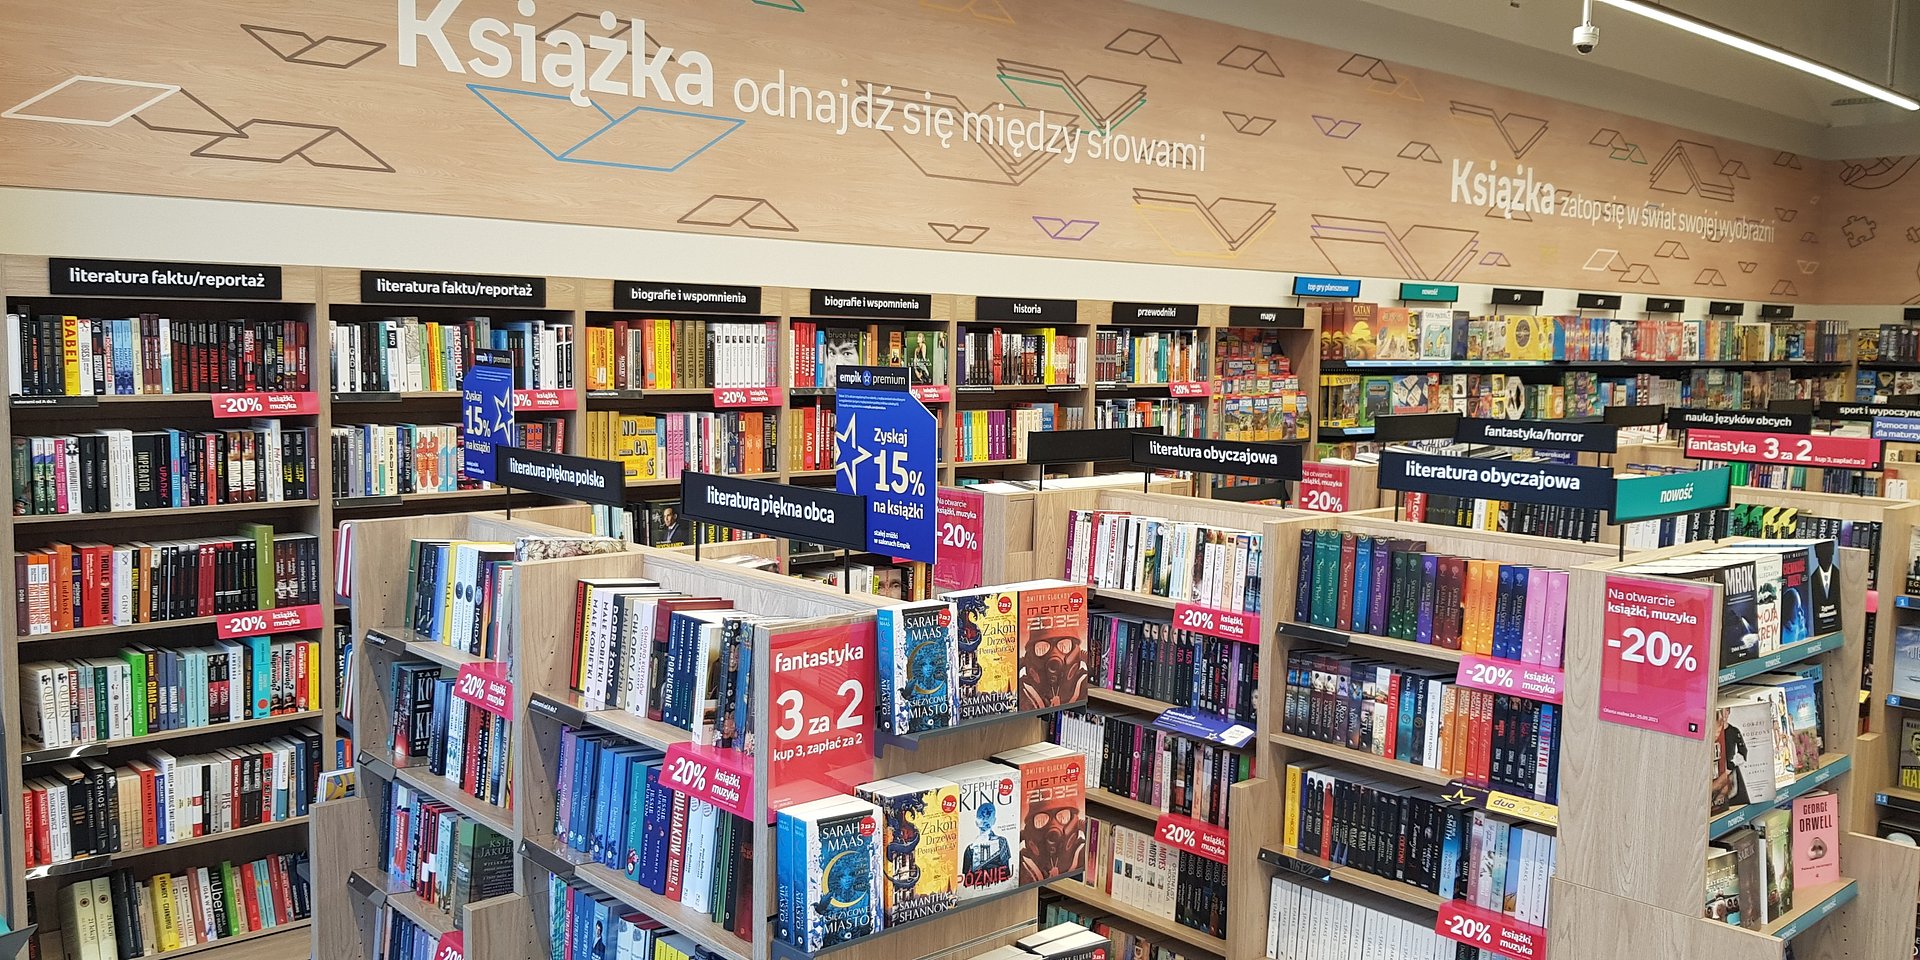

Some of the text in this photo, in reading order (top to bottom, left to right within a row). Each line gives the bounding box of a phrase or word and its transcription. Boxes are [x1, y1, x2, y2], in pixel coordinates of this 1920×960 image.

[397, 0, 1207, 172] Książka odnajdź się między słowami
[1450, 158, 1775, 244] Książka zatop się w świat swojej wyobraźni
[69, 267, 265, 289] literatura faktu/reportaż
[376, 278, 533, 299] literatura faktu/reportaż
[631, 288, 747, 307] biografie wspomnienia
[824, 296, 920, 313] biografie wspomnienia
[1013, 302, 1042, 315] historia
[1137, 306, 1177, 319] przewodniki
[1260, 311, 1276, 322] mapy
[1353, 304, 1371, 314] CATAN
[63, 318, 78, 366] BABEL
[453, 325, 463, 383] SEKSOHOLICY
[476, 353, 511, 366] empik premium
[839, 371, 906, 386] empik premium
[465, 389, 483, 405] Zyskaj
[536, 392, 558, 400] książki,
[718, 391, 747, 404] -20%
[1172, 384, 1190, 396] -20%
[219, 395, 297, 413] -20% książki, muzyka
[1839, 407, 1864, 415] sport
[465, 405, 491, 437] 15%
[1685, 413, 1792, 427] nauka języków obcych
[1876, 421, 1908, 429] Pomoce
[874, 428, 908, 445] Zyskaj
[1485, 425, 1584, 443] fantastyka/horror
[1150, 440, 1278, 467] literatura obyczajowa
[1534, 450, 1571, 460] Superokazja!
[1687, 437, 1813, 461] fantastyka 3 za 2
[139, 451, 149, 493] IMPERATOR
[159, 465, 168, 499] UPADEK
[509, 457, 546, 478] literatura
[547, 462, 576, 485] piękna
[576, 467, 605, 488] polska
[874, 449, 926, 497] 15%
[1310, 471, 1333, 479] otwarcie
[1405, 461, 1580, 492] literatura obyczajowa
[1301, 490, 1343, 512] -20%
[1659, 482, 1694, 503] nowość
[707, 485, 835, 524] literatura piękna obca
[873, 499, 924, 520] na książki
[956, 509, 977, 520] muzyka
[937, 522, 978, 551] -20%
[101, 554, 109, 618] TROLLE PUTINA
[1724, 563, 1756, 597] MROK
[1608, 588, 1676, 607] Na otwarcie
[224, 611, 301, 633] -20% książki, muzyka
[906, 616, 939, 629] SARAH
[1026, 613, 1080, 631] 2035
[1179, 609, 1244, 635] -20% książki, muzyka
[1607, 602, 1697, 626] książki, muzyka
[911, 627, 942, 641] MAAS
[983, 622, 1016, 636] Zakon
[608, 605, 619, 688] DOBRE ŻONY
[630, 613, 639, 672] CHŁOPCY
[987, 635, 1016, 646] Drzewa
[1607, 627, 1698, 672] -20%
[587, 631, 597, 680] KOBIETKI
[775, 643, 864, 673] fantastyka
[271, 650, 281, 692] Naprawdę?
[285, 649, 295, 691] Naprawdę?
[1465, 663, 1556, 695] -20% książki, muzyka
[459, 672, 486, 700] -20%
[665, 655, 675, 709] PORZUCENIE
[44, 684, 54, 720] QUEEN
[61, 682, 69, 719] QUEEN
[775, 679, 864, 741] 3 za 2
[962, 692, 1011, 706] SAMANTHA
[1891, 697, 1897, 705] 5
[907, 703, 948, 718] MIASTO
[962, 703, 1009, 718] SHANNON
[773, 736, 854, 762] kup zapłać za
[96, 772, 107, 808] KOSMOS
[668, 756, 741, 802] -20% książki, muzyka
[958, 790, 1012, 813] KING
[1026, 785, 1079, 804] 2035
[1492, 798, 1516, 809] duo
[1876, 795, 1888, 803] 11
[1803, 801, 1828, 815] GEORGE
[822, 824, 860, 842] SARAH
[920, 819, 958, 837] Zakon
[1444, 813, 1454, 841] SMITH
[1799, 814, 1833, 833] ORWELL
[671, 791, 686, 885] BUŁHAKOW MISTRZ
[827, 836, 864, 852] MAAS
[925, 833, 958, 846] Drzewa
[1115, 830, 1125, 856] MOYES
[1161, 823, 1226, 856] -20% książki, muzyka
[1136, 836, 1146, 864] MOYES
[1148, 841, 1157, 868] MOYES
[1157, 846, 1167, 871] MOYES
[957, 860, 1013, 888] PÓŹNIEJ
[210, 882, 223, 910] Uber
[898, 892, 949, 911] SAMANTHA
[898, 902, 949, 922] SHANNON
[823, 915, 870, 935] MIASTO
[1444, 914, 1533, 956] -20% książki, muzyka
